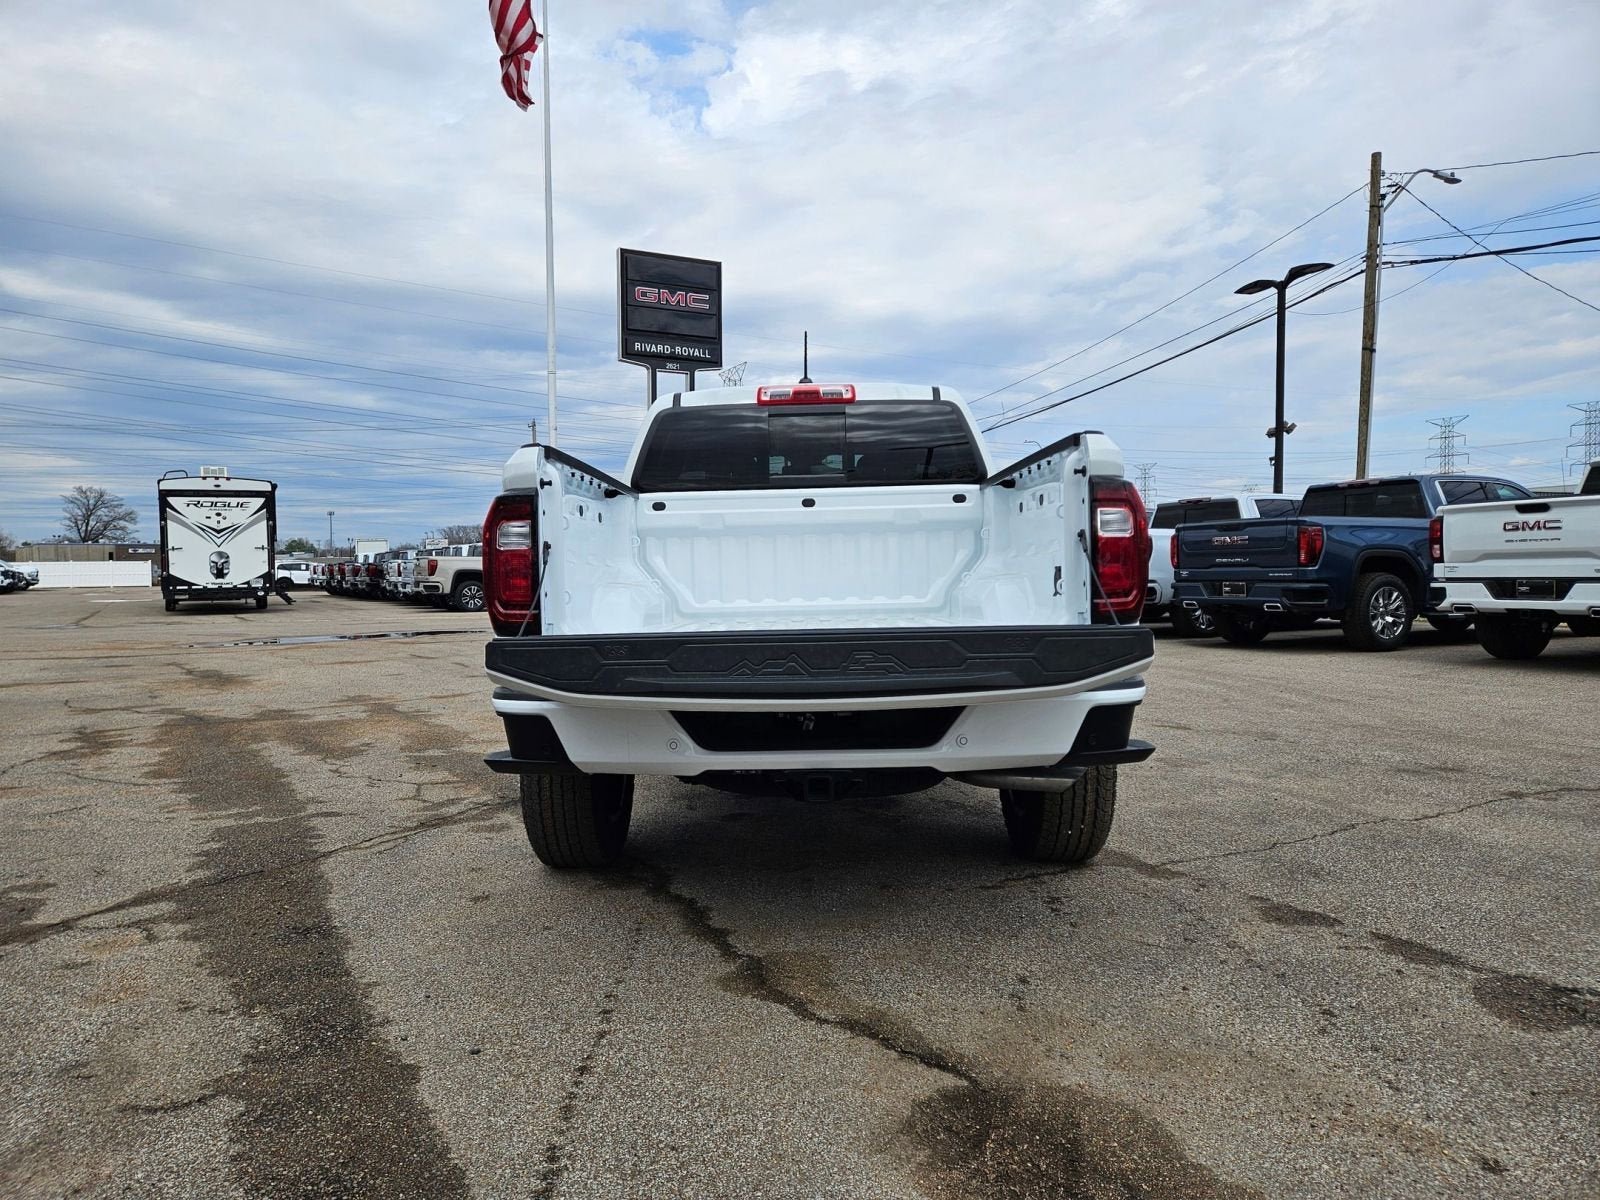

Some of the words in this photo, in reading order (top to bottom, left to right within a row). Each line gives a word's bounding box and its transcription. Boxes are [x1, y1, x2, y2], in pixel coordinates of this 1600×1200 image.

[635, 286, 710, 310] GMC
[634, 342, 711, 359] RIVARD-ROYALL
[184, 500, 251, 509] ROGUE
[1503, 519, 1562, 532] GMC
[1212, 535, 1249, 545] GMC
